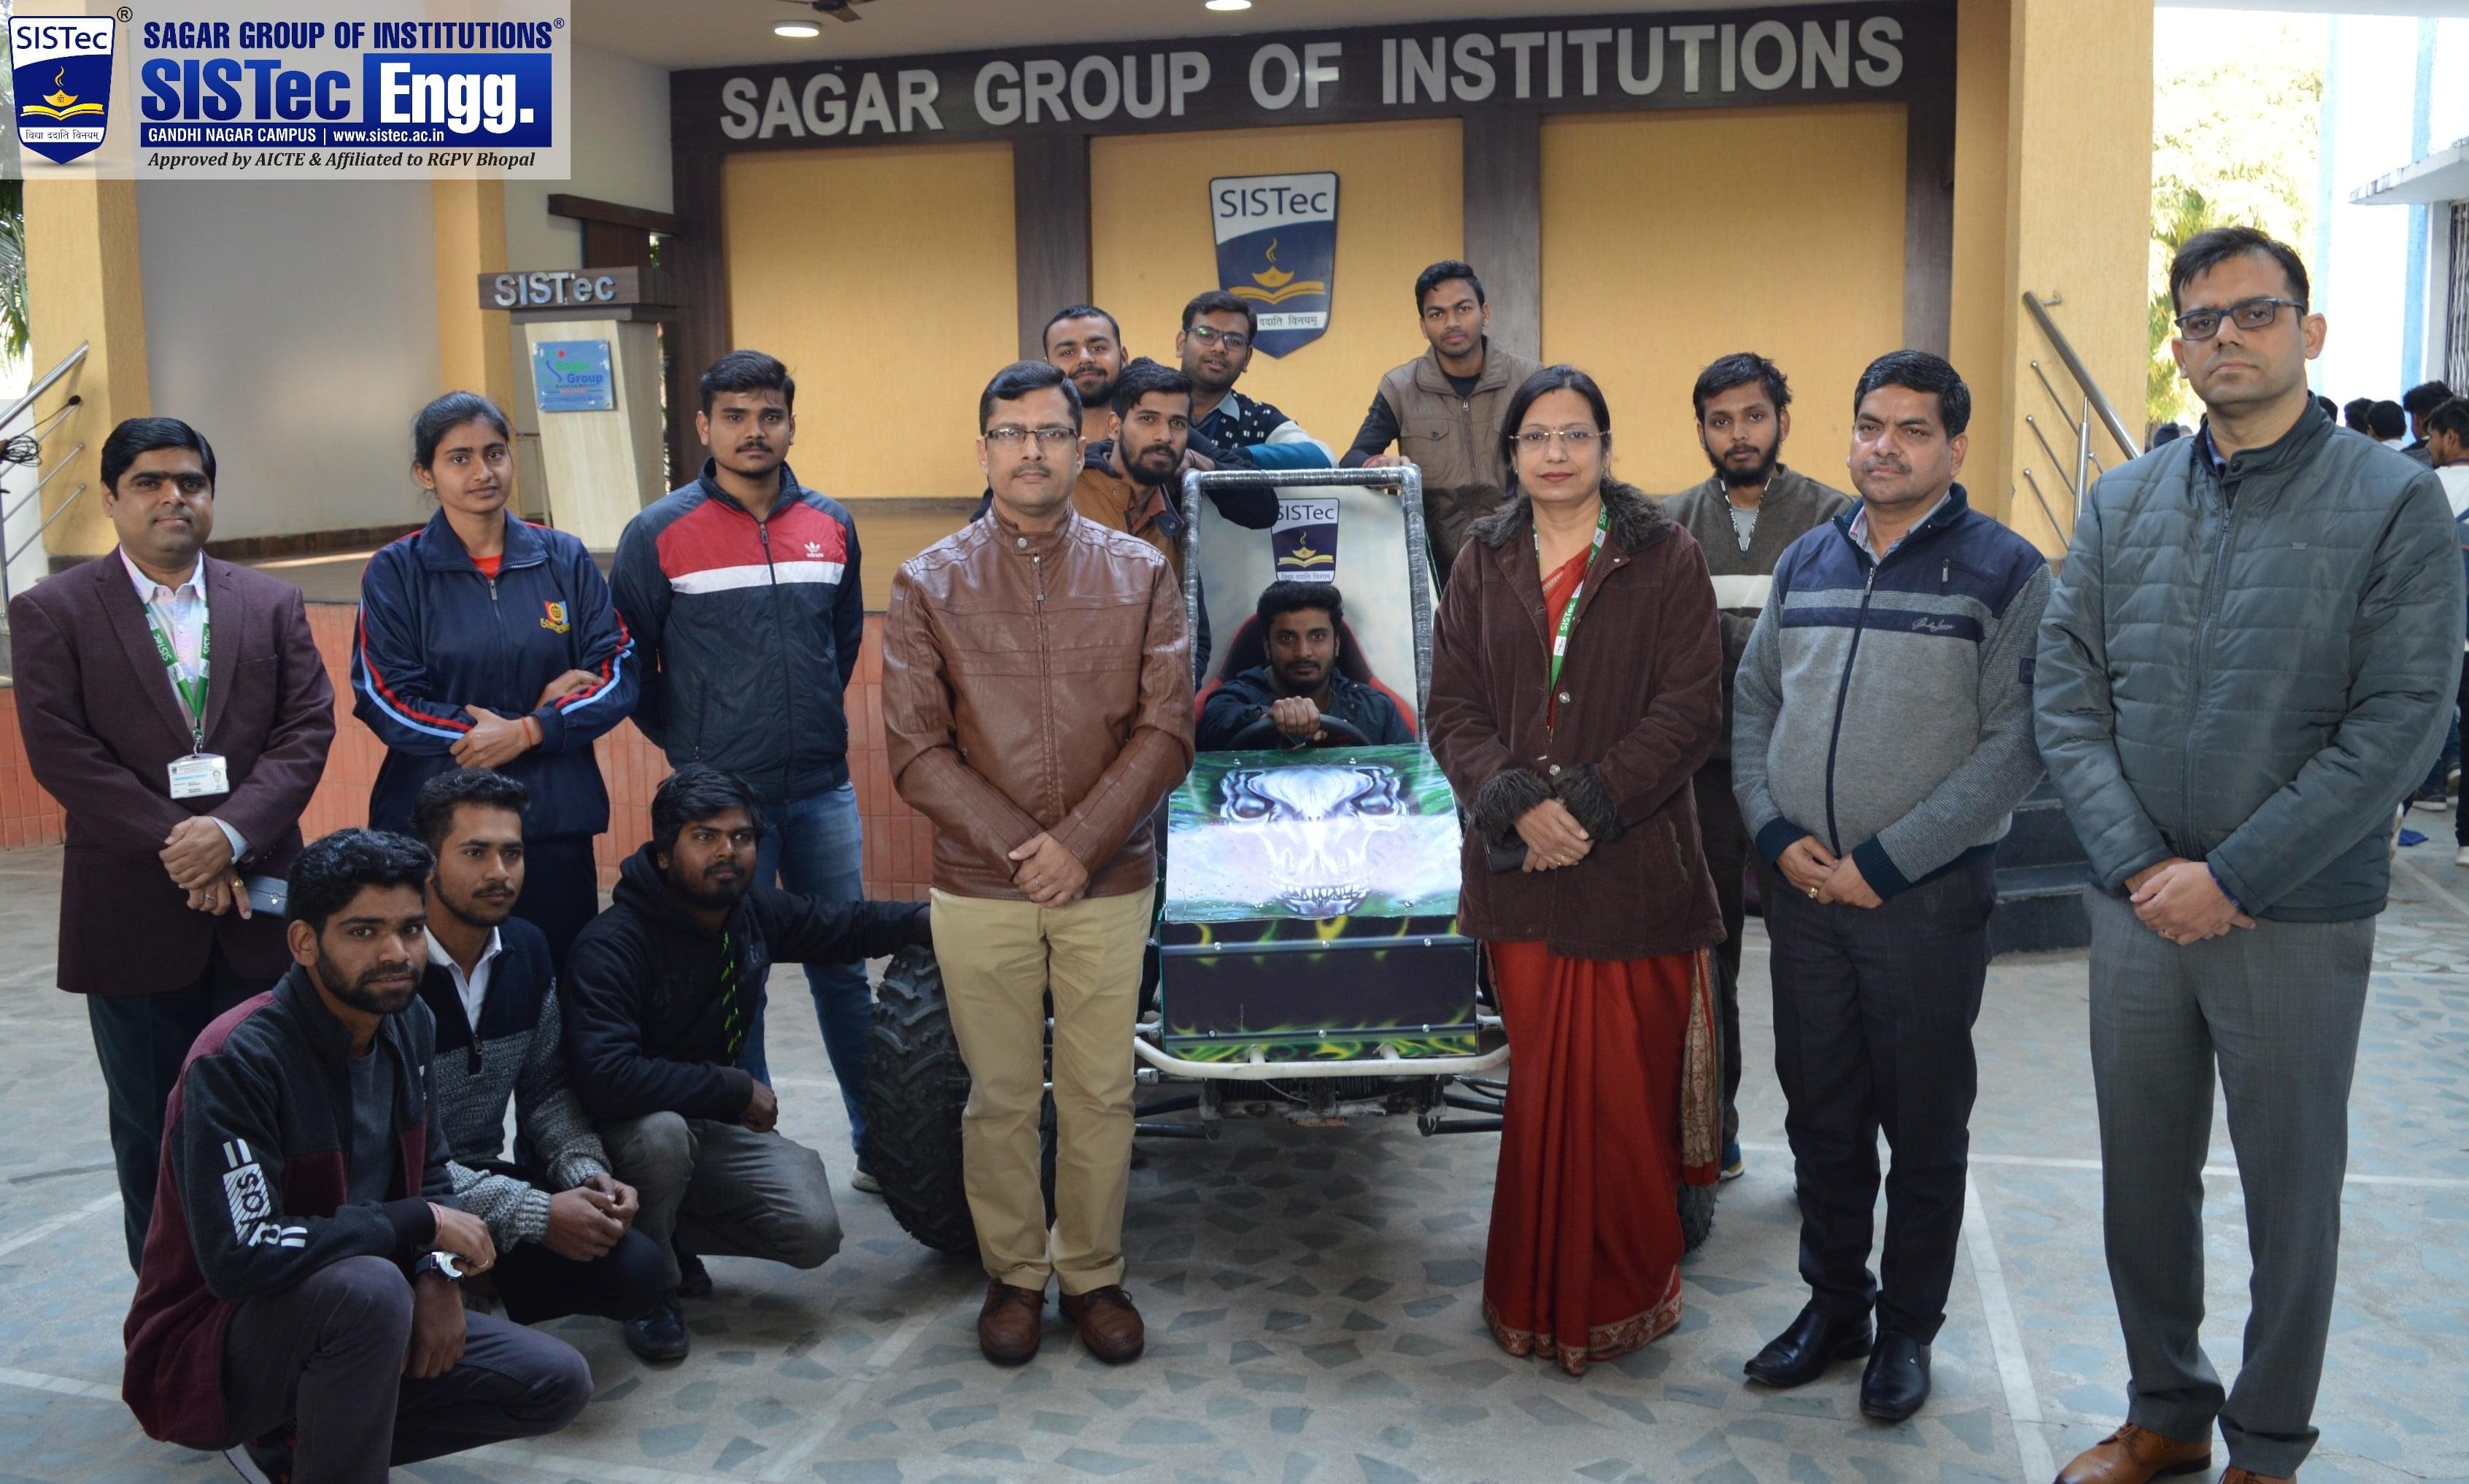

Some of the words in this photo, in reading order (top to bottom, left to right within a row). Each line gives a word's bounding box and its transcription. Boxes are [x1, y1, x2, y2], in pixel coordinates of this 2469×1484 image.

[720, 68, 944, 139] SAGAR
[973, 54, 1211, 125] GROUP
[1248, 41, 1342, 110] OF
[1382, 15, 1904, 105] INSTITUTIONS
[1219, 187, 1328, 218] SISTec
[494, 271, 615, 306] SISTec
[567, 373, 603, 385] Group
[1560, 602, 1576, 631] SISTec
[153, 633, 172, 661] SISTec
